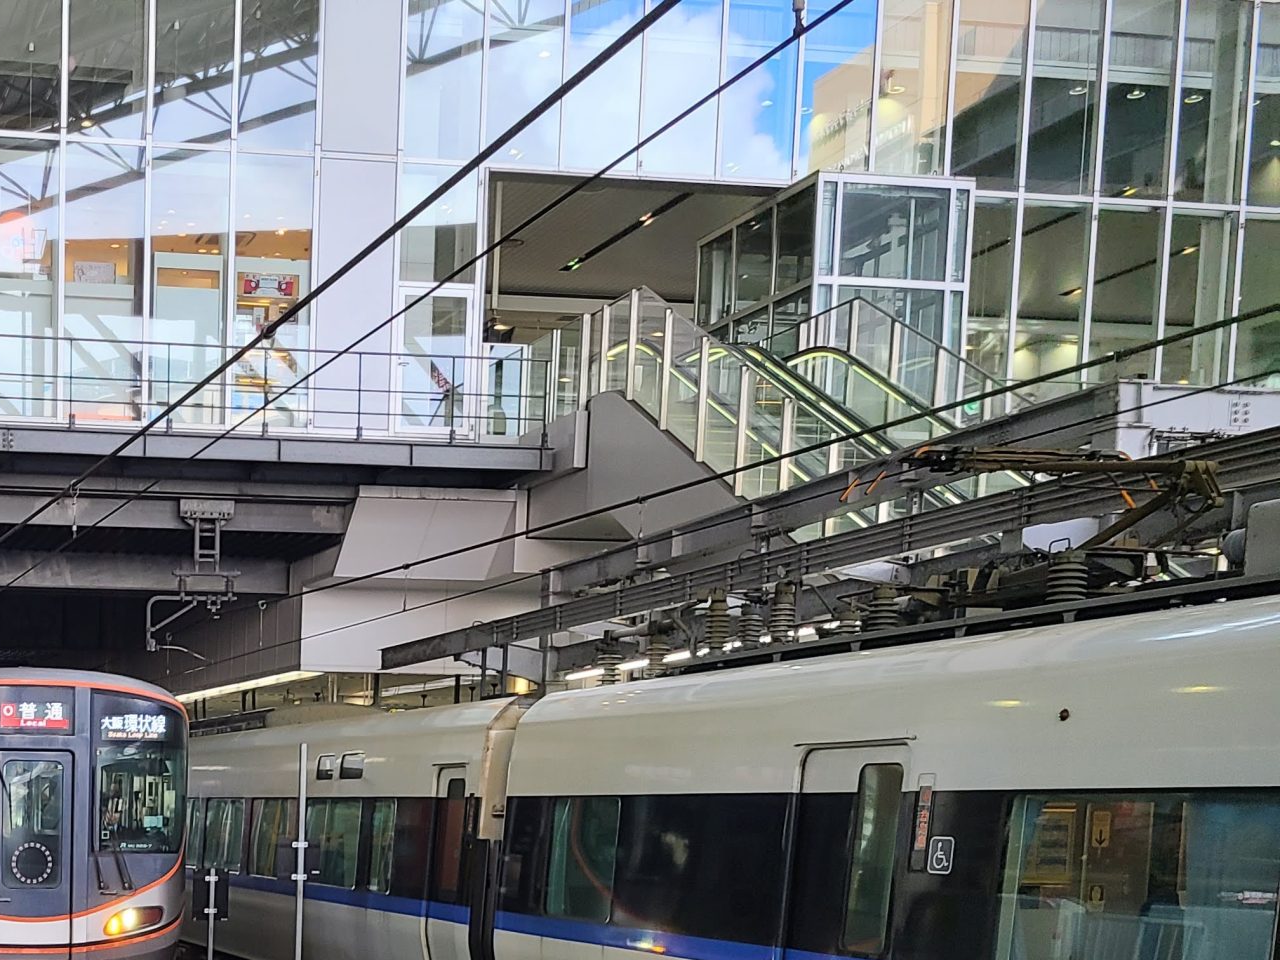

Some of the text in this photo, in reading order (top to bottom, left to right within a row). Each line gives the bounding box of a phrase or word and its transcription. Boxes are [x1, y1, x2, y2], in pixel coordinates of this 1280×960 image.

[18, 701, 64, 721] 普通
[20, 719, 47, 728] Local
[100, 713, 167, 734] 大阪環状線
